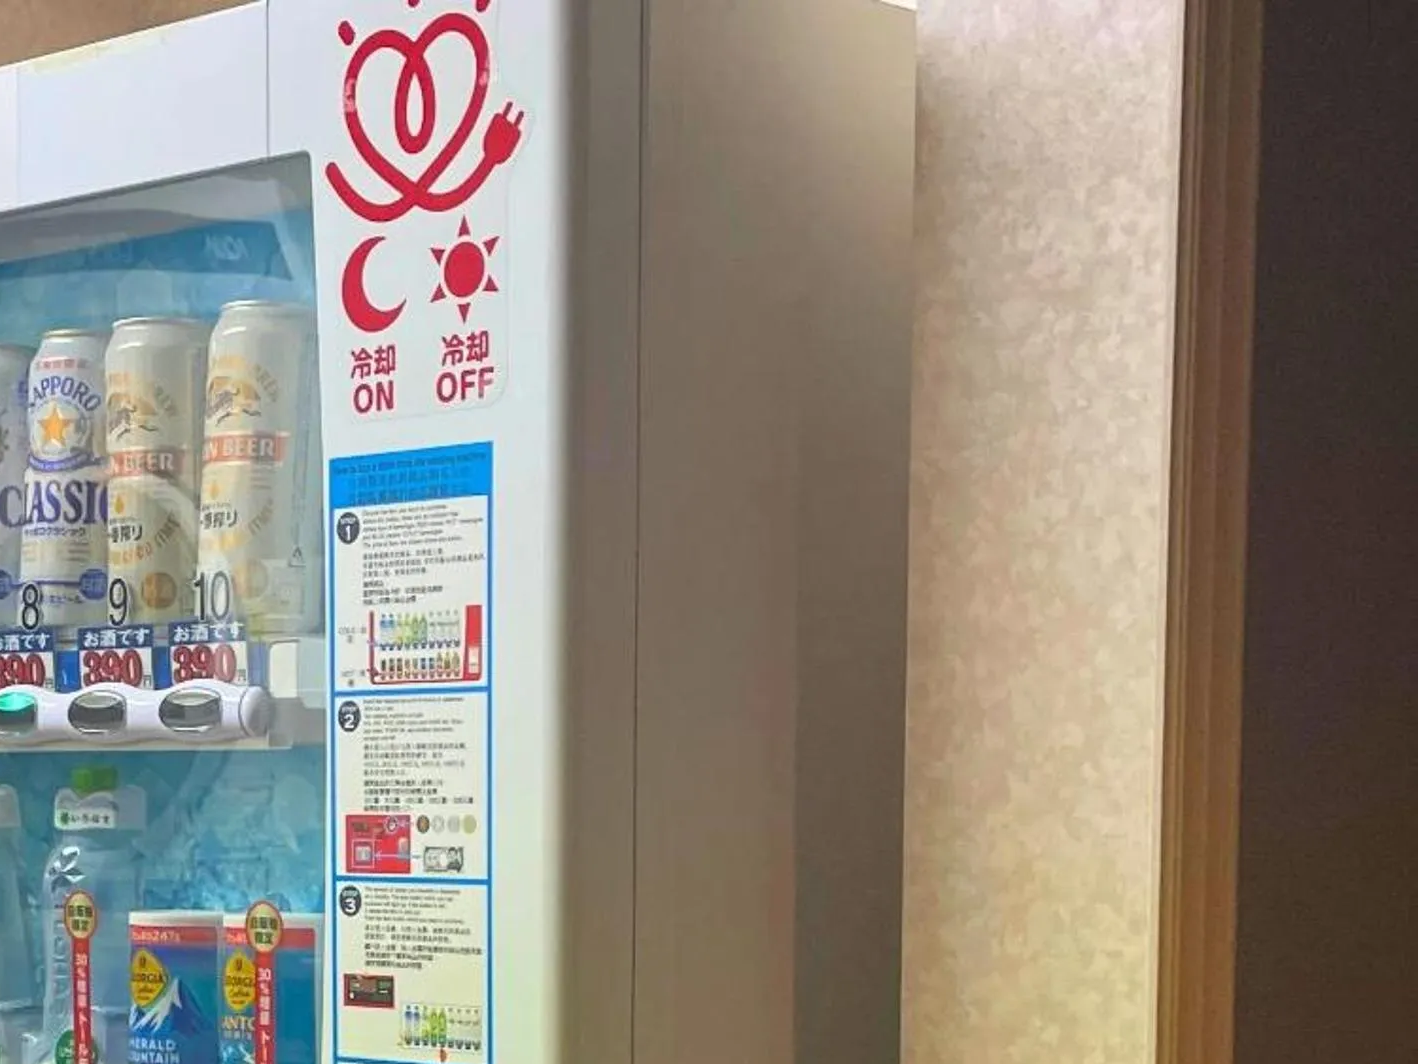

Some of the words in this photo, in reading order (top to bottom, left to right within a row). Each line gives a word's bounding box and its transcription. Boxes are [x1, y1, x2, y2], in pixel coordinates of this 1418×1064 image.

[351, 344, 397, 379] 冷却
[441, 330, 490, 367] 冷却
[30, 375, 101, 413] APPORO
[352, 381, 395, 414] ON
[436, 367, 494, 403] OFF
[125, 451, 174, 473] BEER
[225, 438, 275, 457] BEER
[345, 525, 352, 541] 1
[21, 584, 40, 630] 8
[109, 578, 128, 627] 9
[194, 570, 230, 621] 10
[84, 628, 150, 647] お酒です
[173, 621, 244, 643] お酒です
[343, 713, 355, 729] 2
[344, 898, 357, 913] 3
